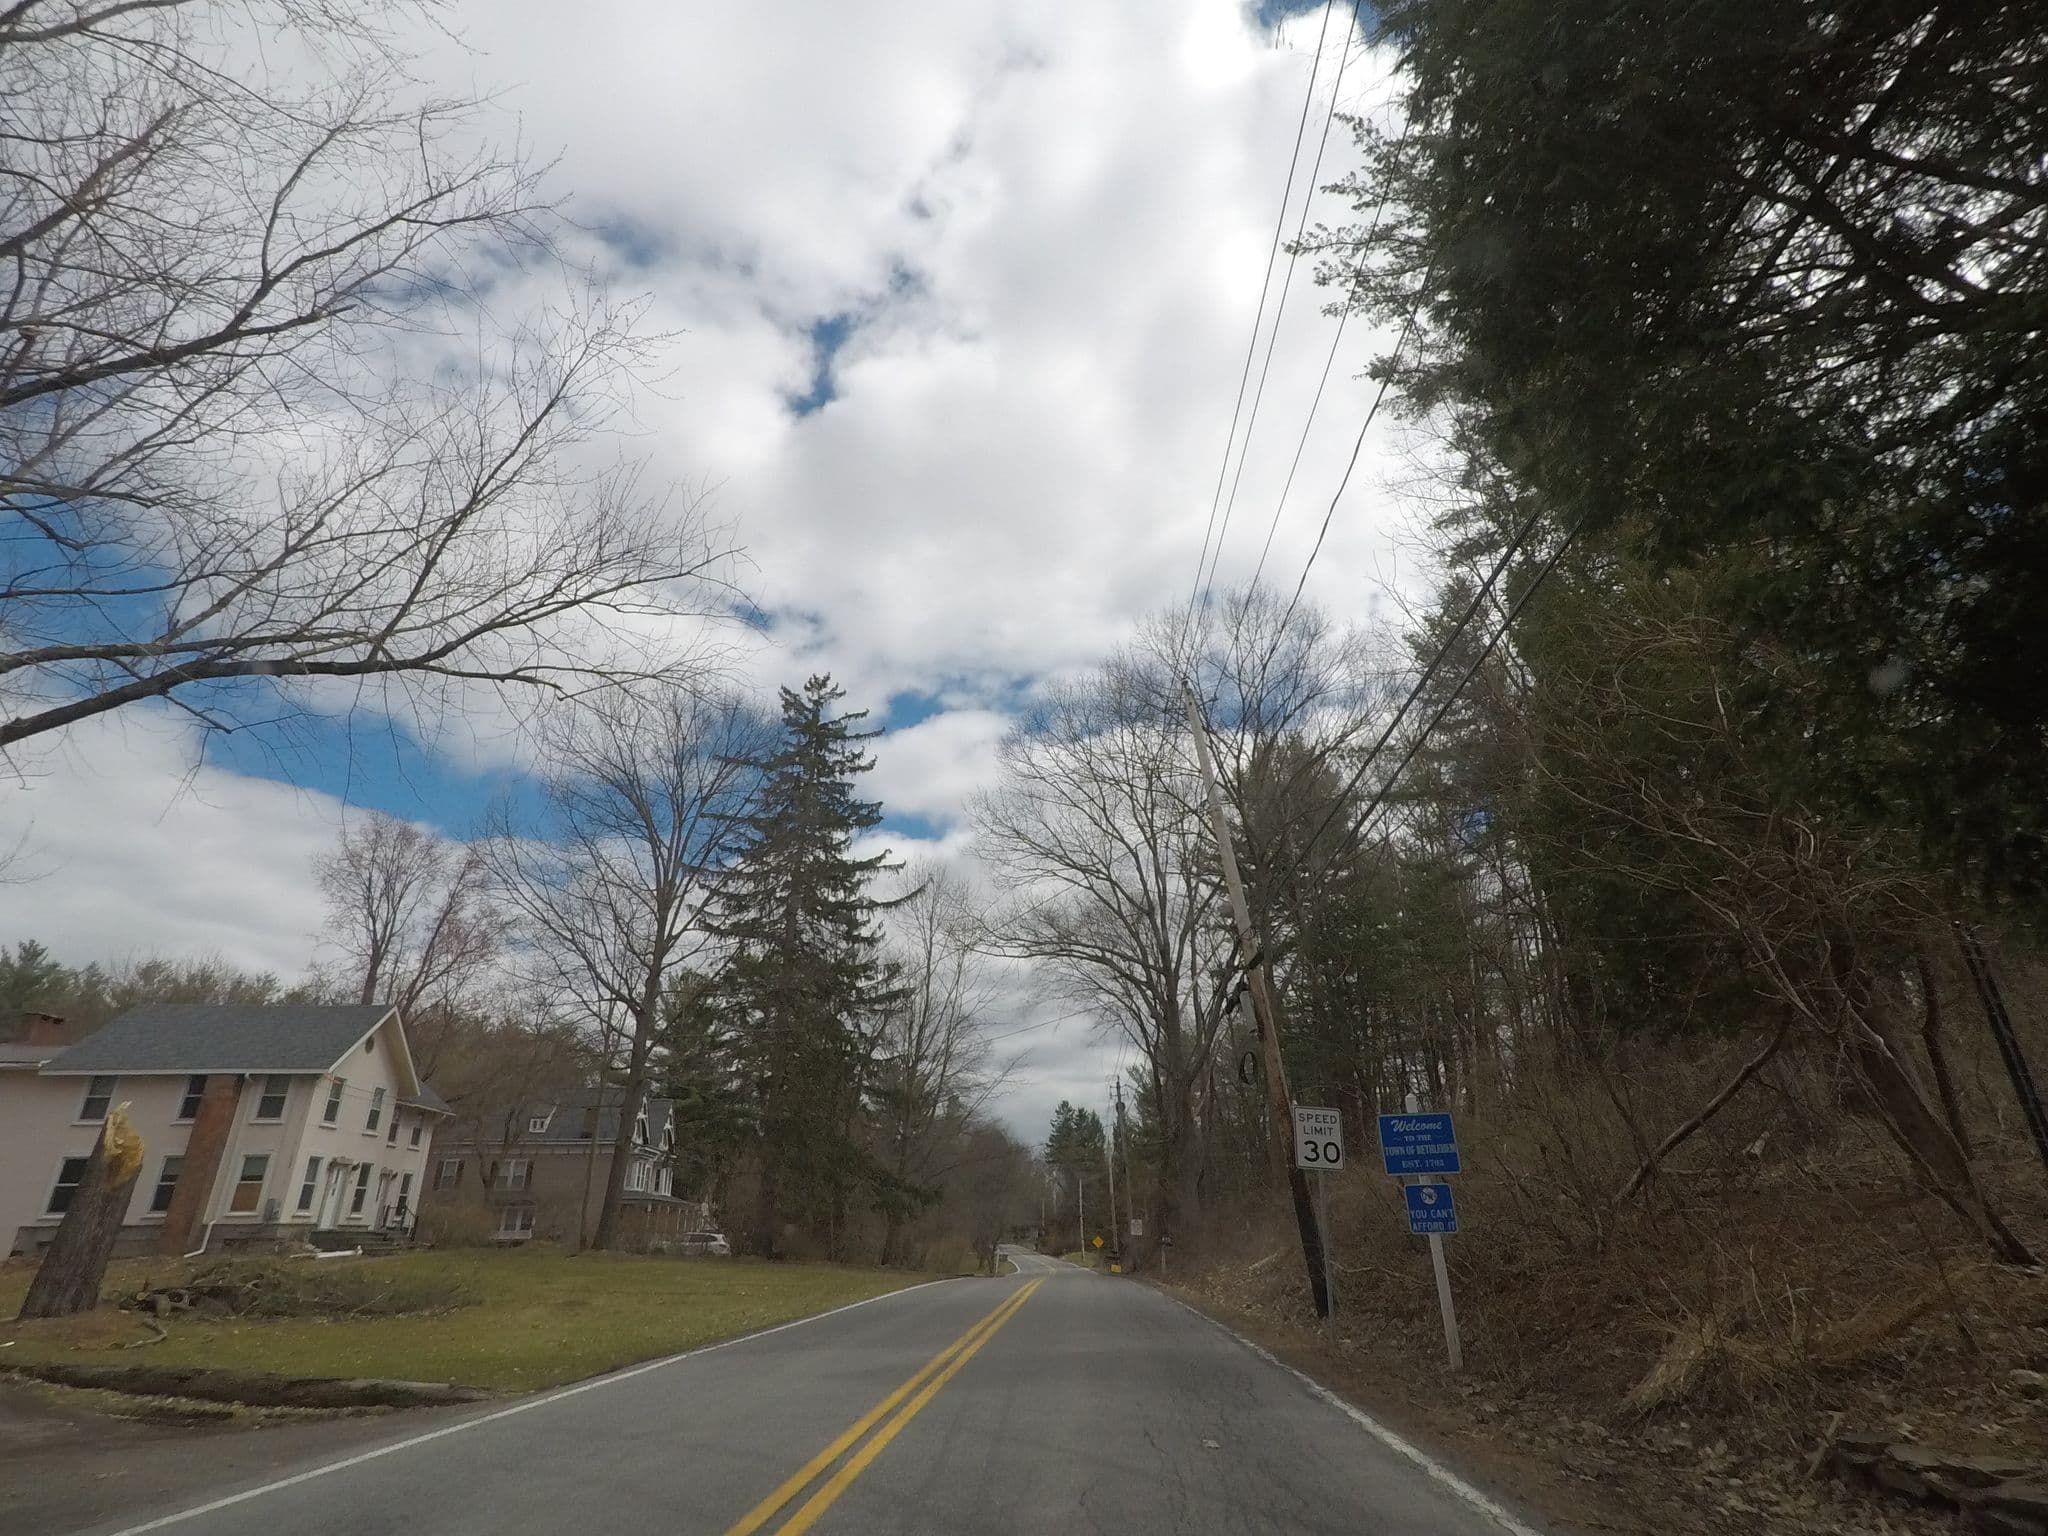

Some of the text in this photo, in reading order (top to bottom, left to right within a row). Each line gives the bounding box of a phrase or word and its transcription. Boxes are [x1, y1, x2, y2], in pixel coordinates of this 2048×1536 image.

[1298, 1113, 1337, 1124] SPEED
[1303, 1125, 1333, 1136] LIMIT
[1391, 1119, 1442, 1132] Welcome
[1304, 1140, 1340, 1163] 30
[1385, 1146, 1405, 1156] TOWN
[1406, 1145, 1415, 1155] OF
[1410, 1209, 1427, 1219] YOU
[1413, 1221, 1456, 1231] AFFORD IT
